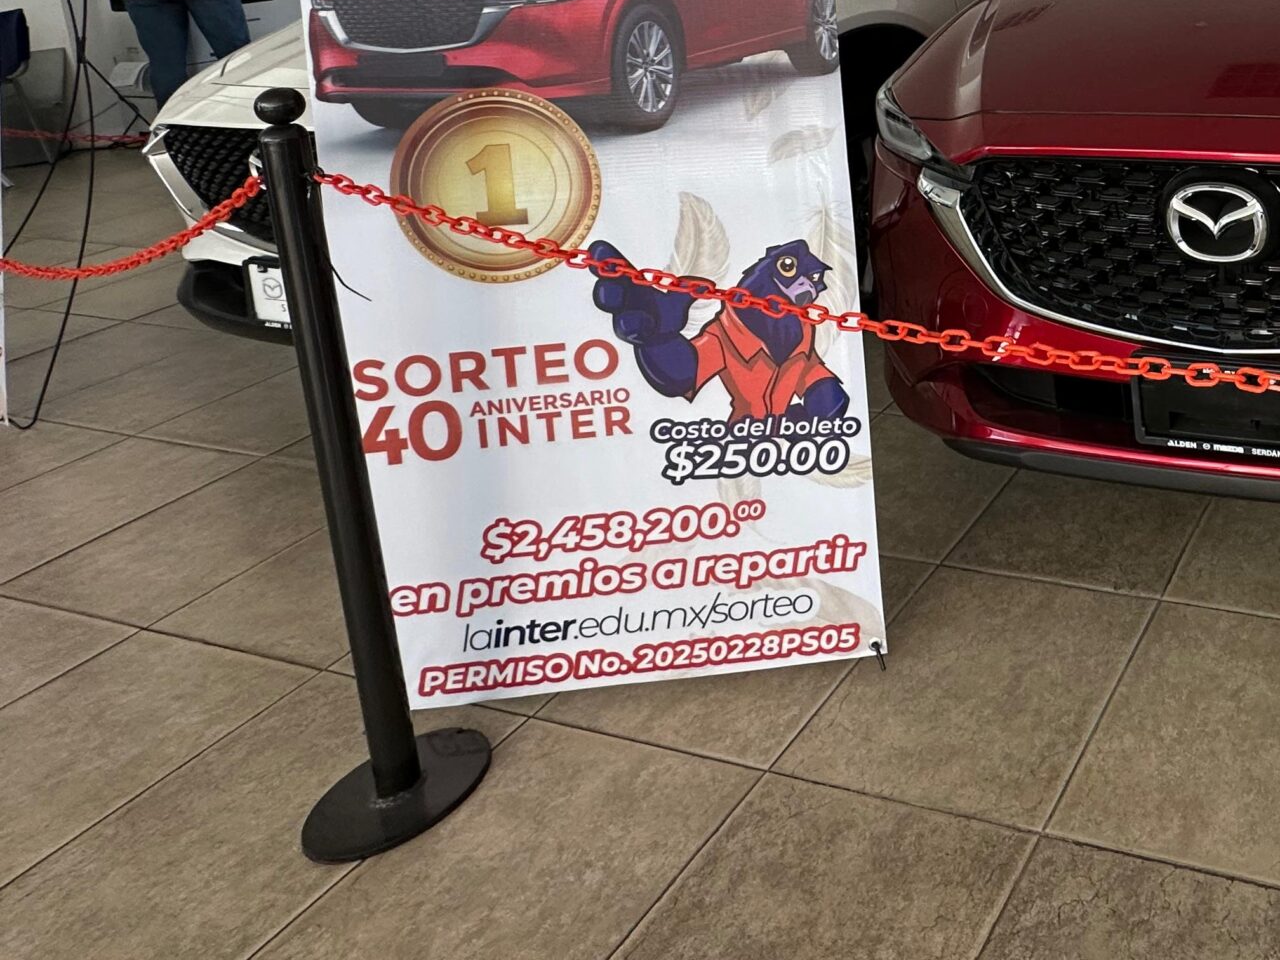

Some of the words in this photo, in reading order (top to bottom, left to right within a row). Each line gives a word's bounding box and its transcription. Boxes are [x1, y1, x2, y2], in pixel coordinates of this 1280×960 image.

[465, 143, 529, 226] 1
[353, 339, 619, 401] SORTEO
[362, 400, 462, 466] 40
[470, 388, 630, 418] ANIVERSARIO
[478, 406, 633, 449] INTER
[655, 418, 728, 439] Costo
[733, 416, 772, 437] del
[779, 416, 858, 437] boleto
[666, 443, 846, 479] $250.00
[484, 502, 763, 563] $2,458,200.00
[391, 586, 449, 614] en
[461, 559, 643, 615] premios
[655, 559, 683, 587] a
[697, 537, 866, 588] repartir
[463, 591, 814, 653] lainter.edu.mx/sorteo
[422, 656, 571, 694] PERMISO
[579, 652, 629, 678] No.
[637, 627, 857, 669] 20250228PS05
